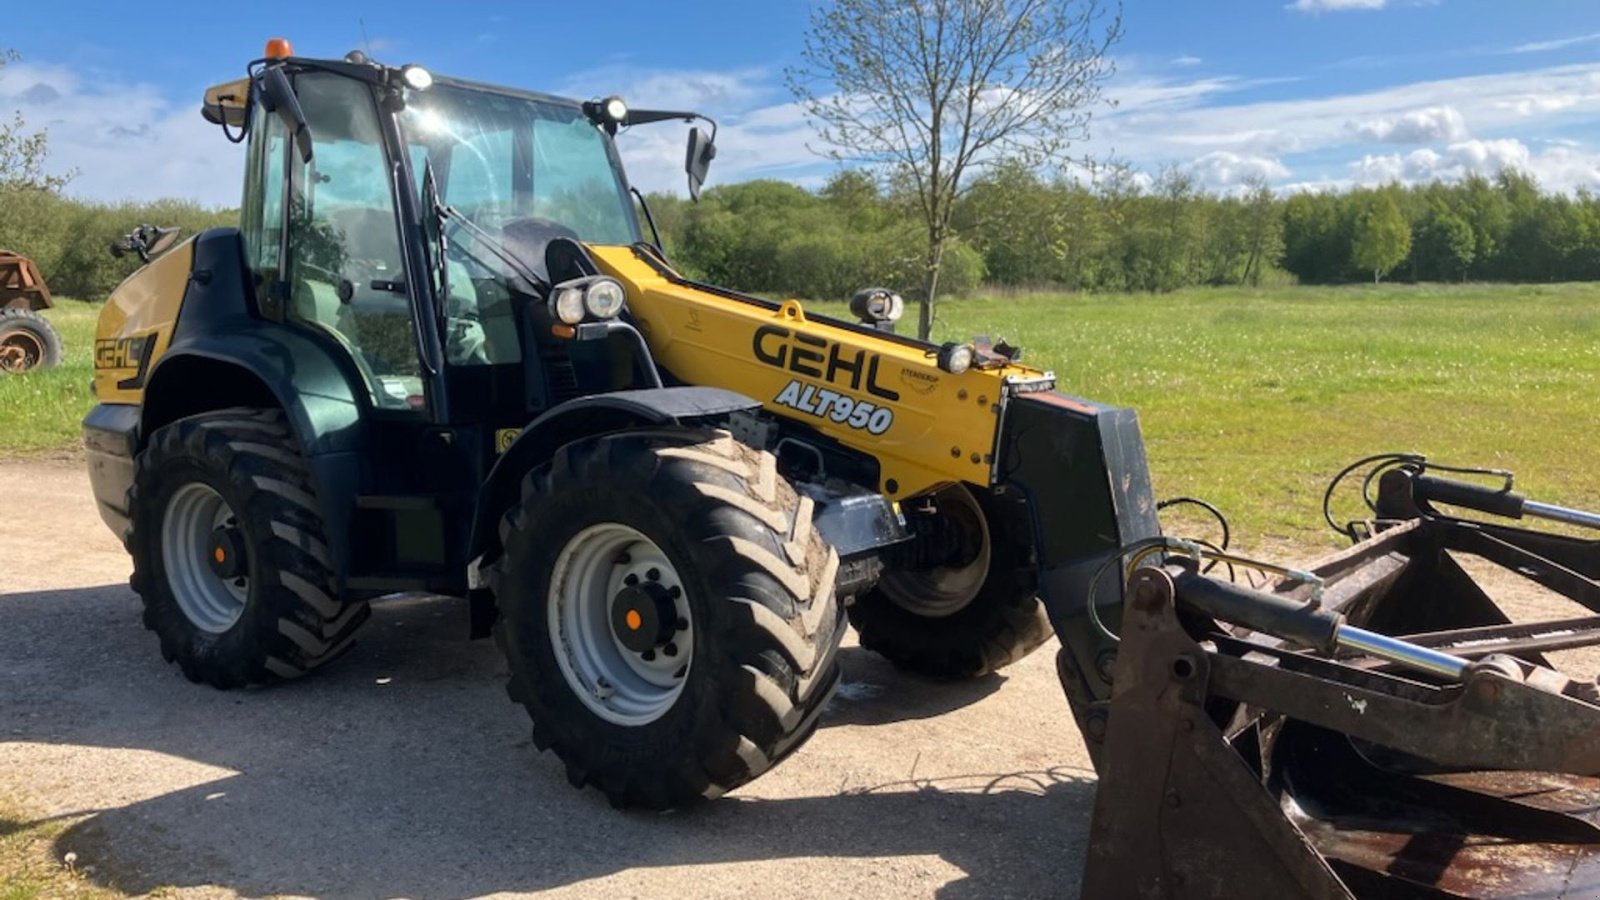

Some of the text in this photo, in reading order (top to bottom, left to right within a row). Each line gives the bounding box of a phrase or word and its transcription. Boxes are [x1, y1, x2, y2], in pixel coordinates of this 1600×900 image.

[95, 338, 139, 369] GEHL
[753, 324, 900, 402] GEHL
[773, 379, 894, 435] ALT950
